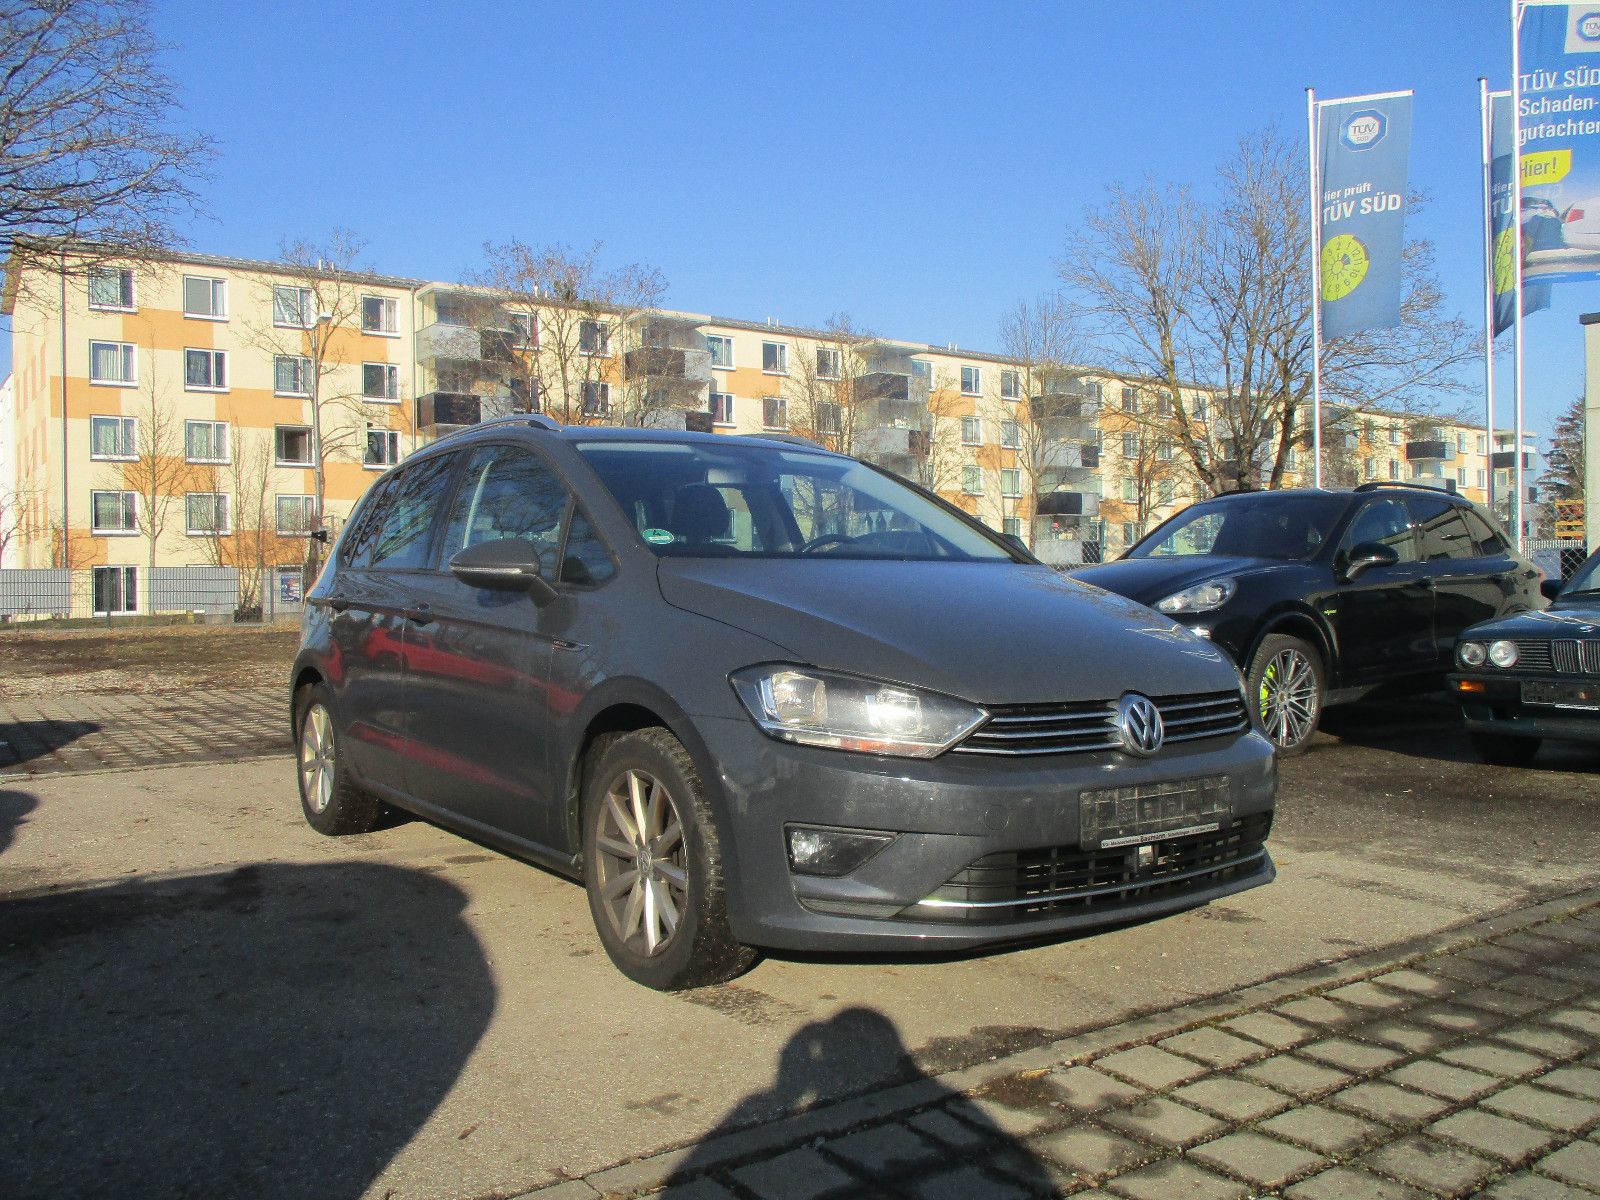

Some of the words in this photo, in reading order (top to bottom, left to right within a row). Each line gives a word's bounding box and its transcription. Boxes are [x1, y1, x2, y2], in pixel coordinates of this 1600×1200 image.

[1519, 69, 1558, 92] TÜV
[1563, 65, 1600, 88] SÜD
[1519, 94, 1600, 117] Schaden-
[1351, 123, 1376, 134] TÜV
[1344, 181, 1373, 198] prüft
[1360, 191, 1401, 215] SÜD
